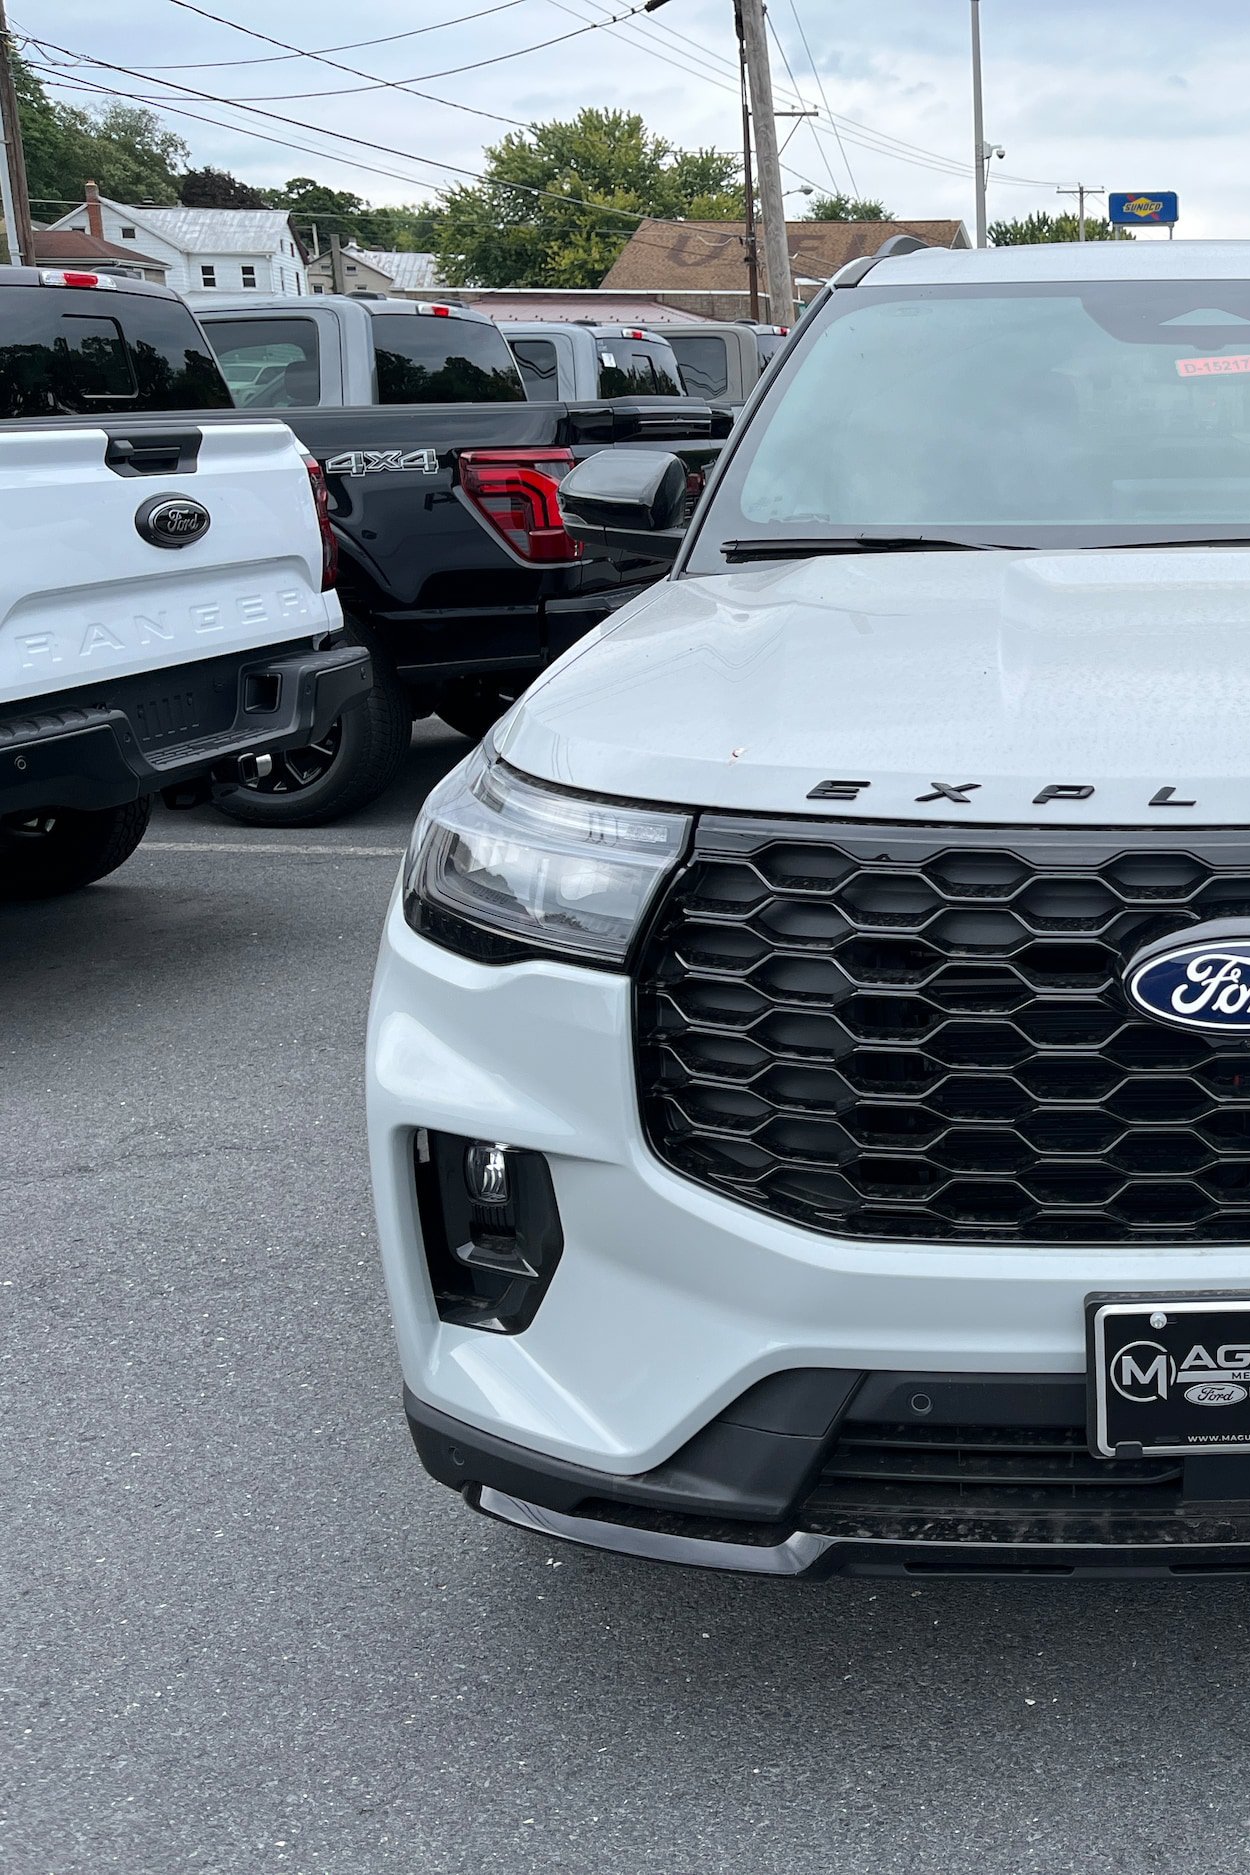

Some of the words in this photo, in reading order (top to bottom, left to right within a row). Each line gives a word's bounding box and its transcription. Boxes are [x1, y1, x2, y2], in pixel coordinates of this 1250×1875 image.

[1123, 202, 1162, 212] SUNOCO
[1183, 359, 1249, 374] D-15217
[166, 509, 199, 533] Ford
[14, 588, 309, 669] RANGER
[1197, 1386, 1234, 1401] Ford
